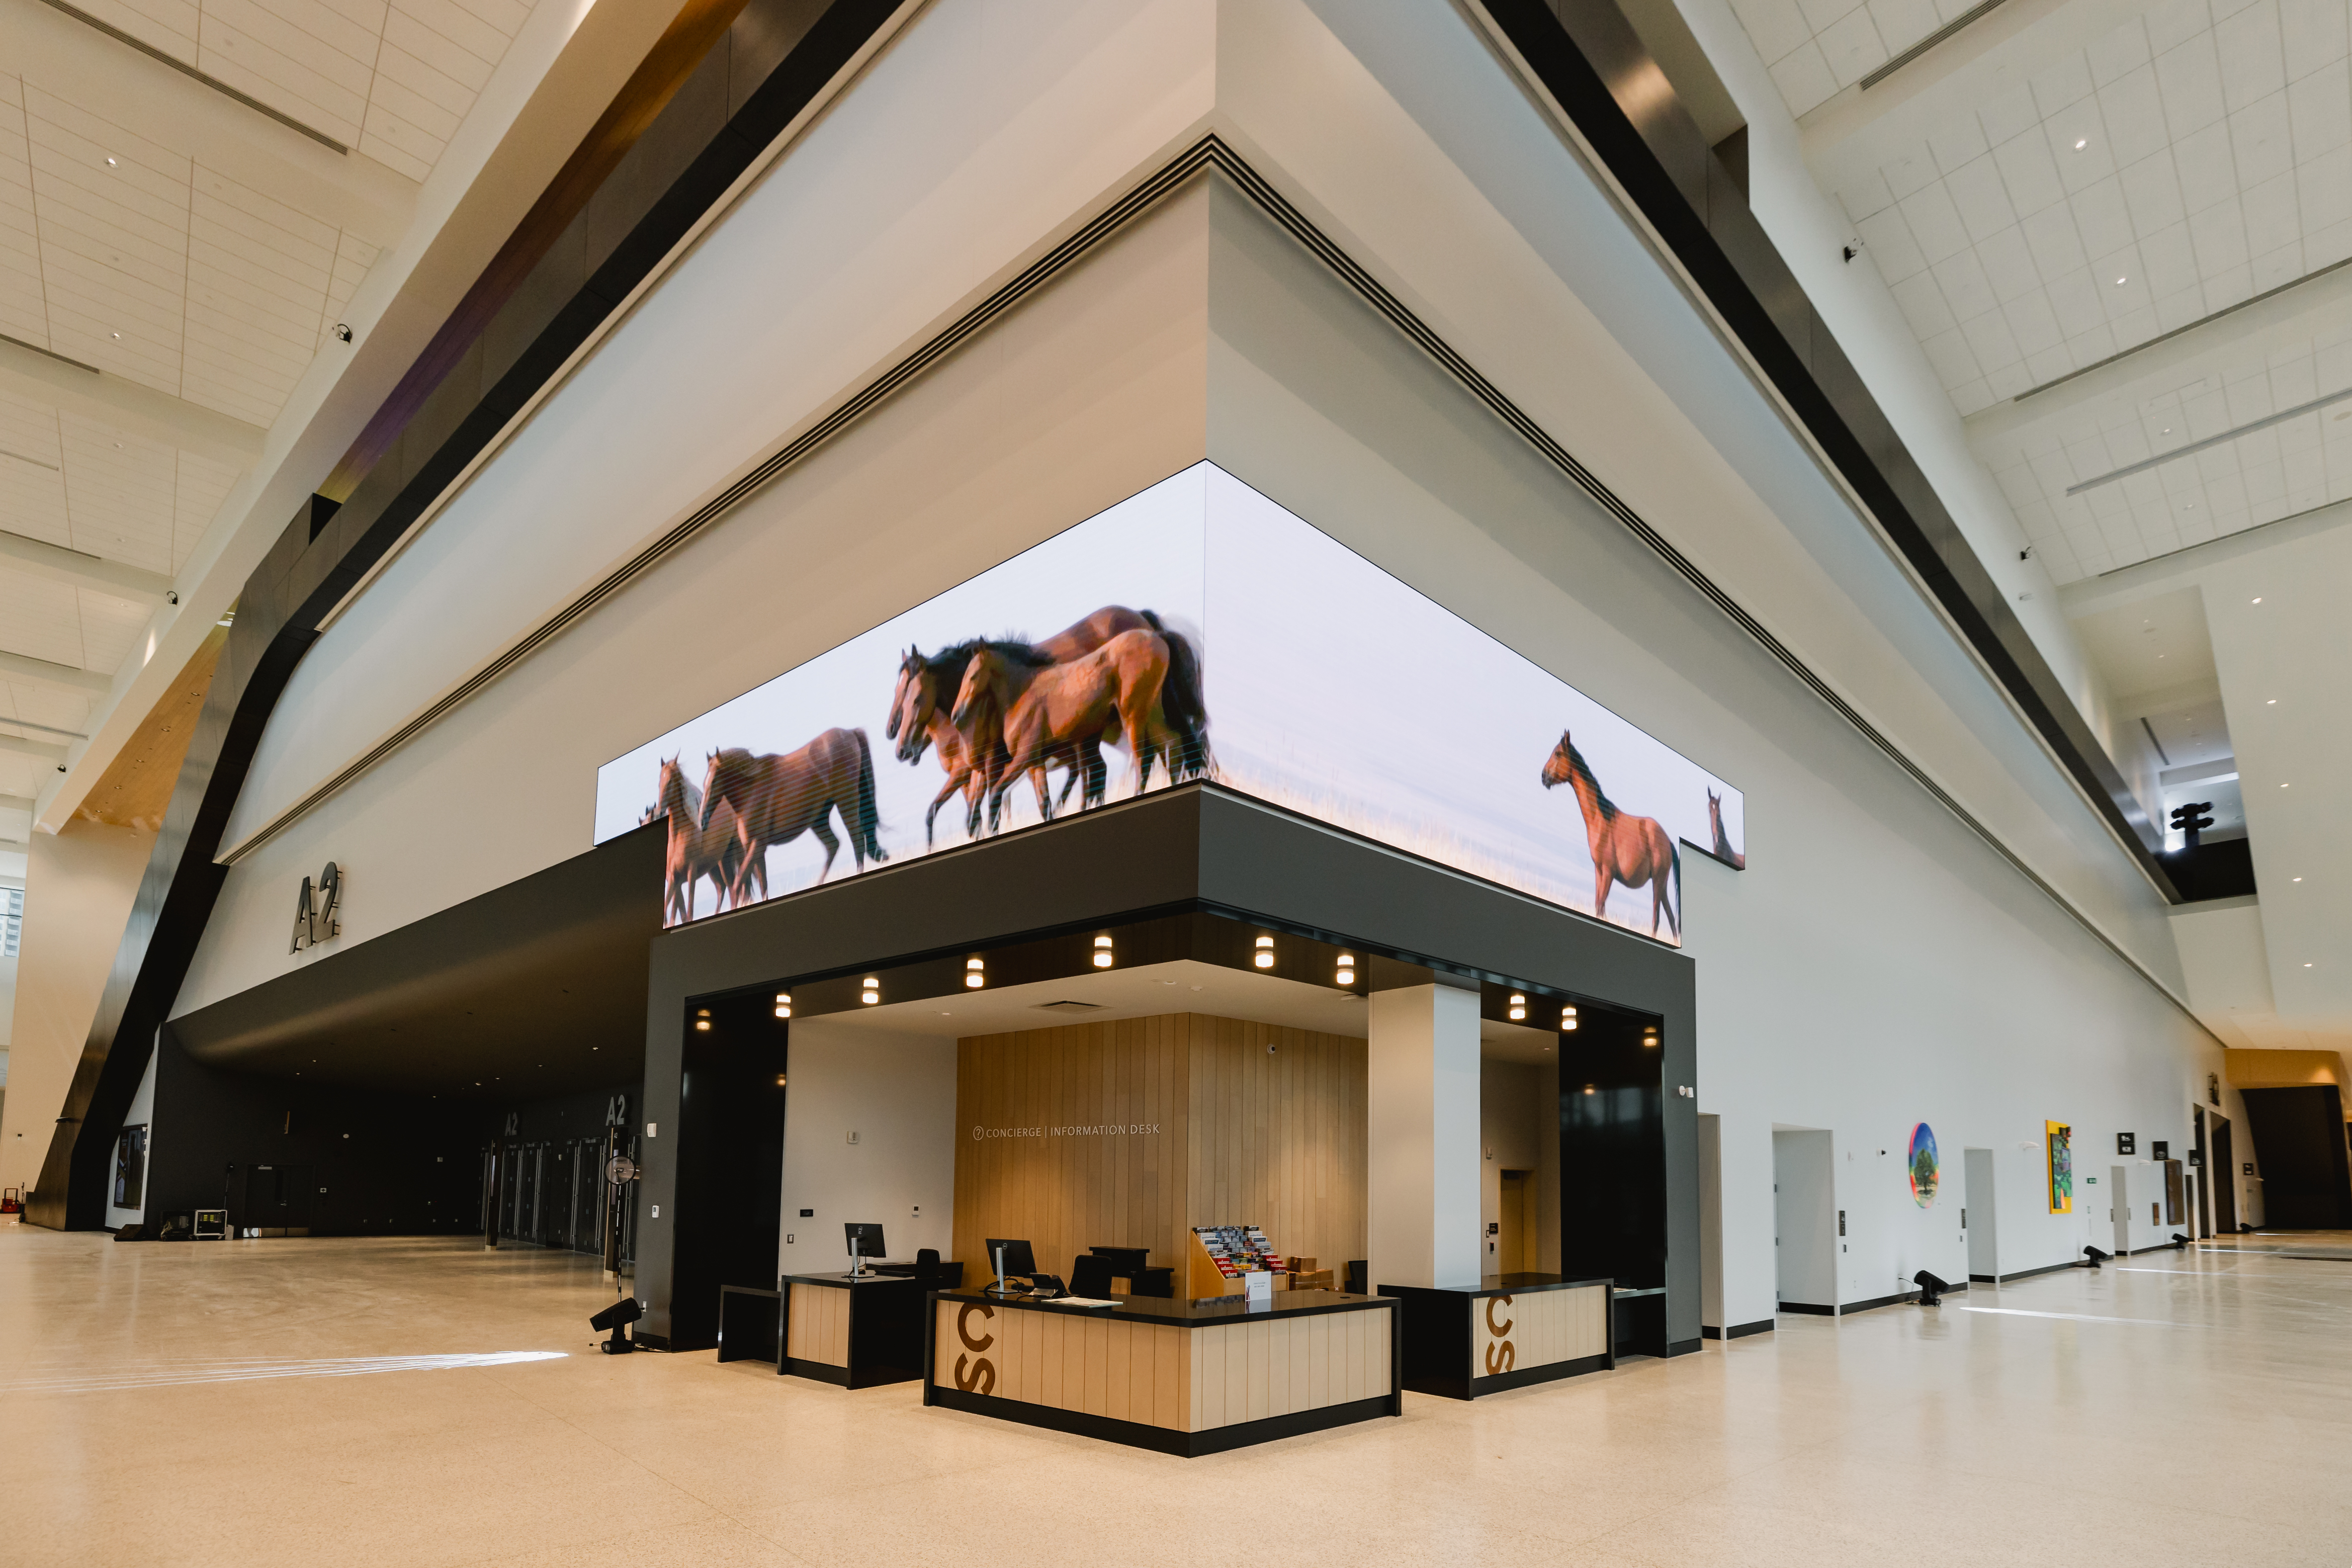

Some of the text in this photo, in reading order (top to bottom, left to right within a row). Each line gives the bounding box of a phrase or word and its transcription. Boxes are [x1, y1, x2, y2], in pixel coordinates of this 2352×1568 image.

[289, 861, 338, 955] A2
[605, 1094, 625, 1126] A2
[504, 1112, 518, 1137] A2
[986, 1123, 1160, 1138] CONCIERGE INFORMATION DESK
